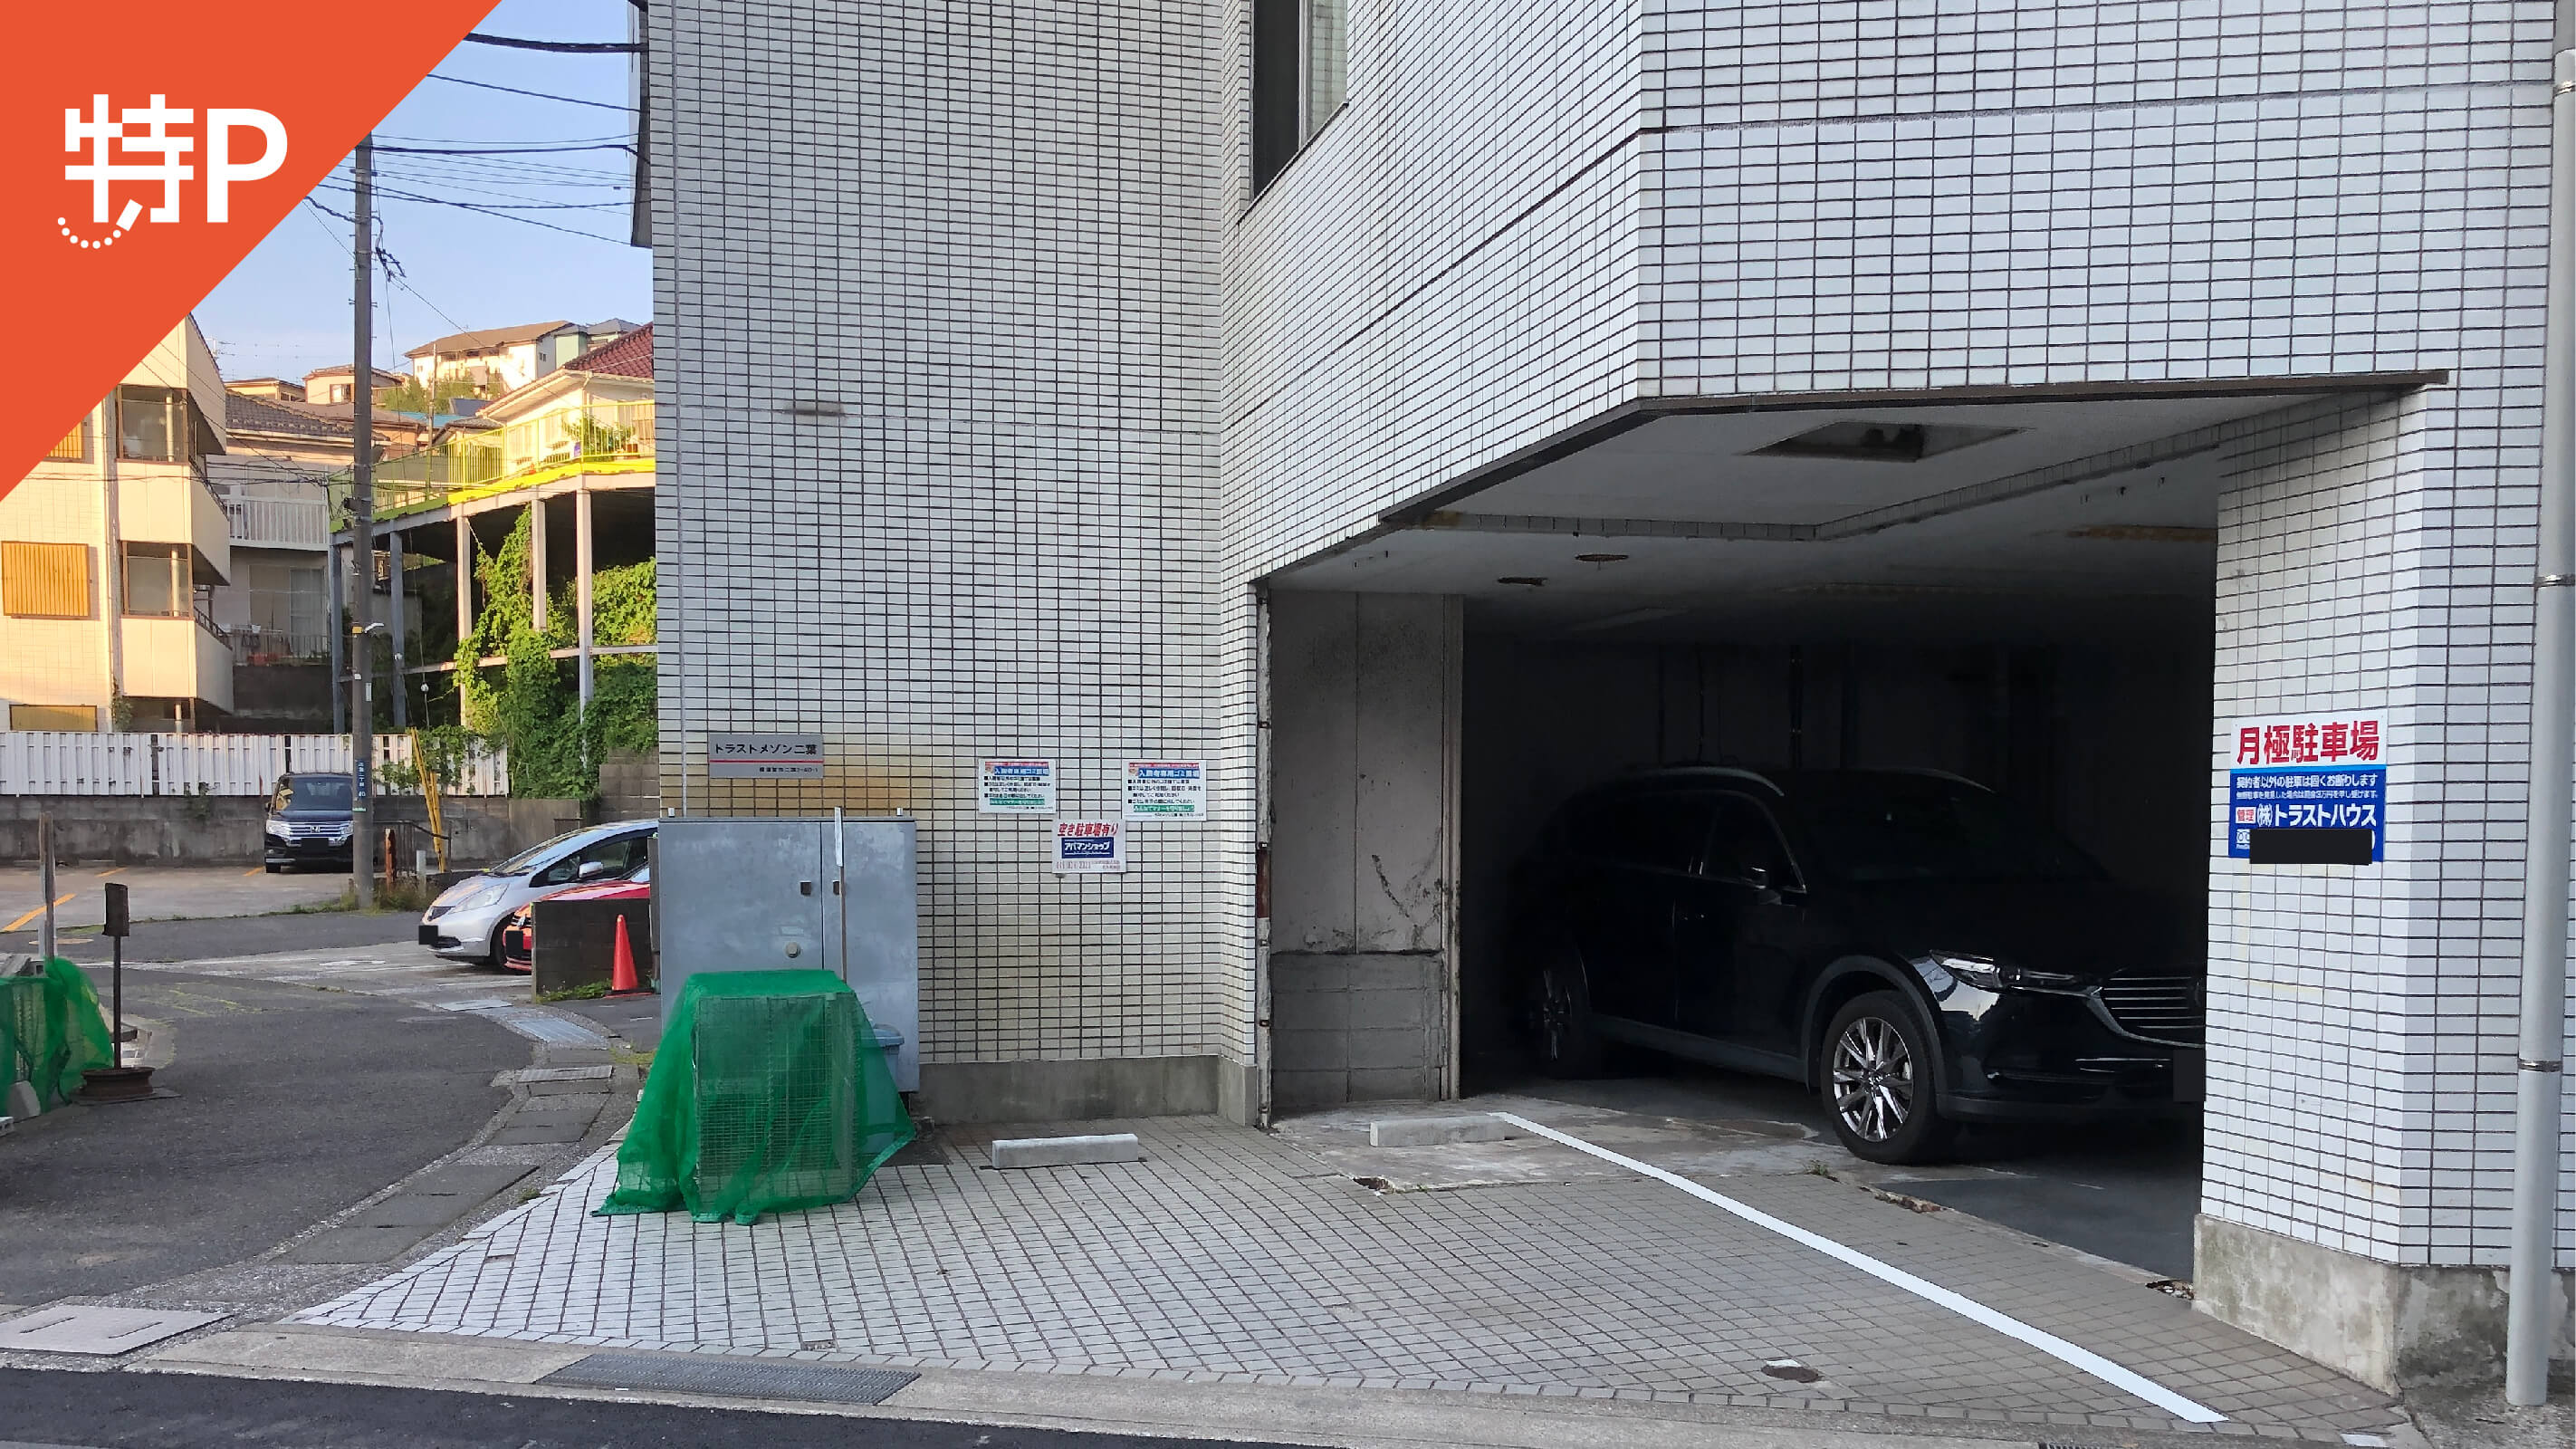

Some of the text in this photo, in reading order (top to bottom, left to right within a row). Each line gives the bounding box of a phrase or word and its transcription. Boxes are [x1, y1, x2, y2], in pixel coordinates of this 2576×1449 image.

[715, 744, 818, 754] トラストメゾン二葉
[2236, 720, 2380, 765] 月極駐車場
[2236, 773, 2379, 790] 契約者以外の駐車は固くお断りします
[2236, 809, 2254, 821] 管理
[1058, 822, 1118, 837] 空き駐車場有り
[1065, 841, 1111, 851] アパマンショップ
